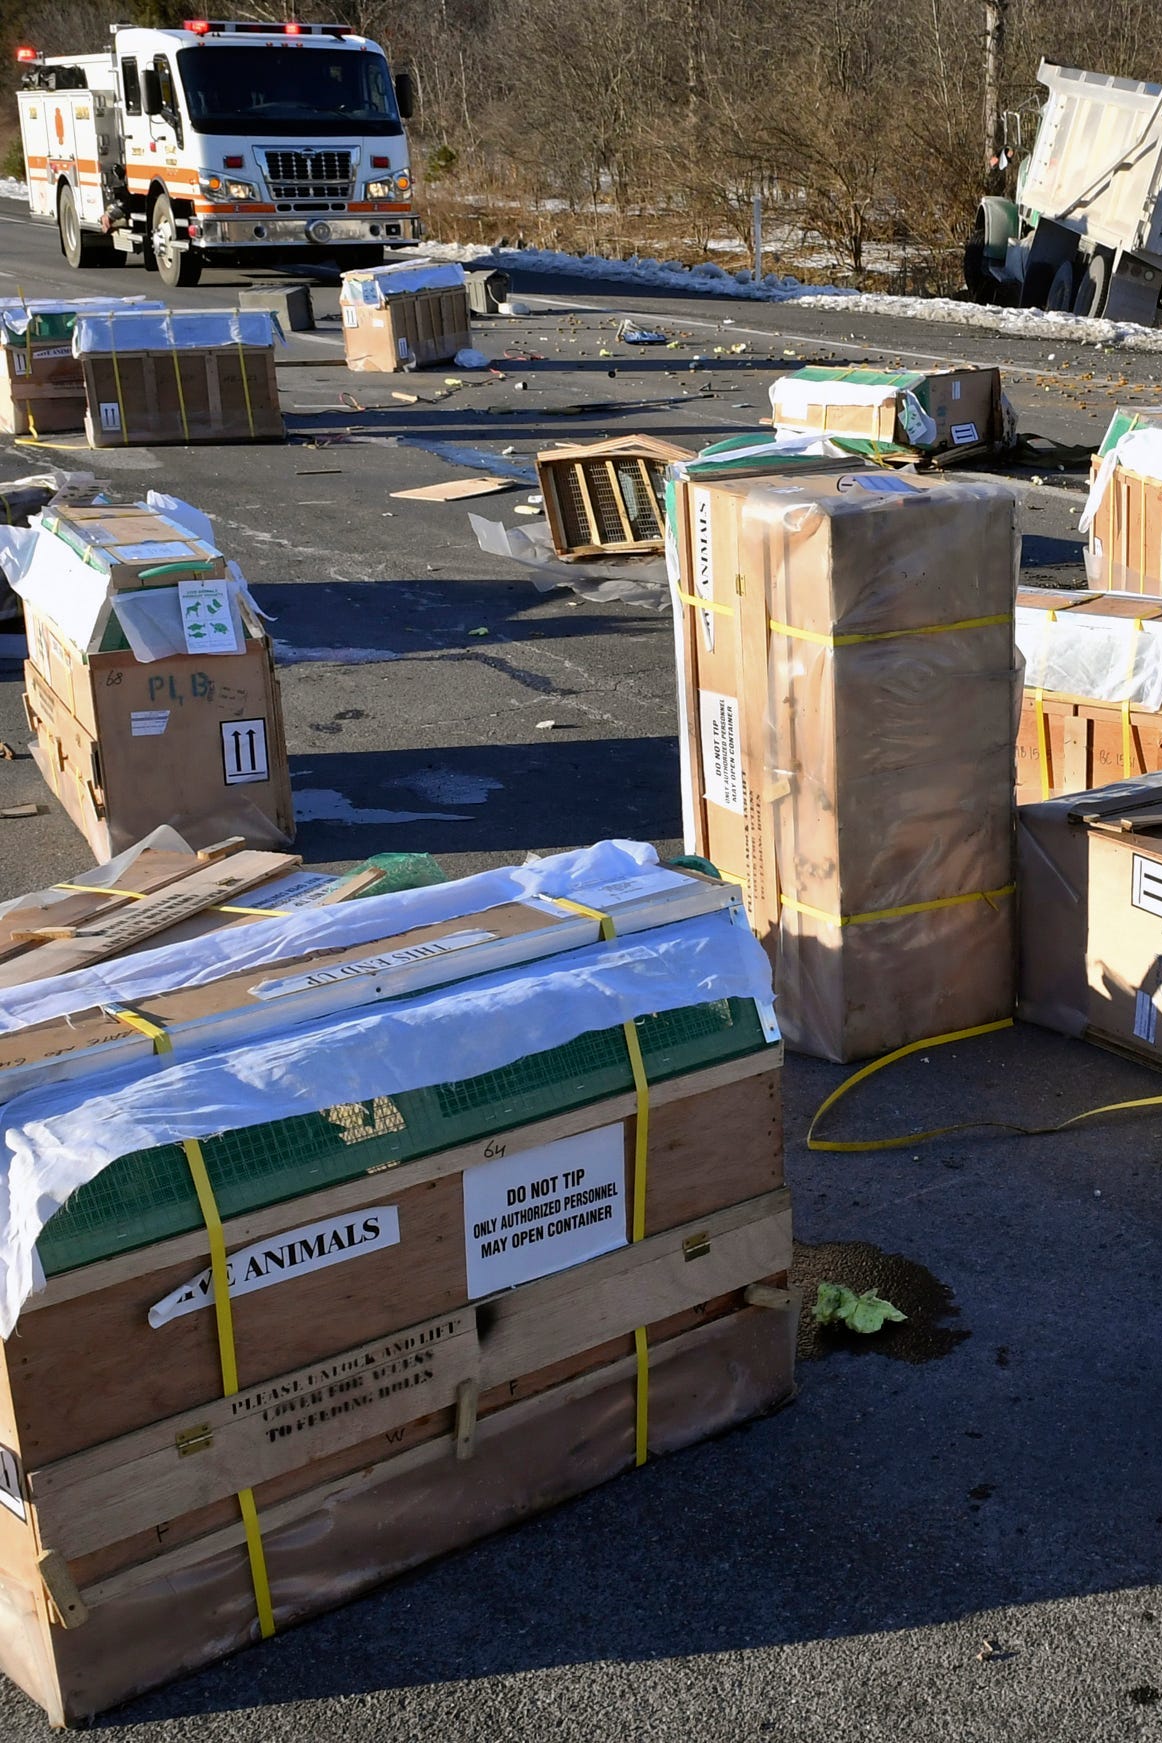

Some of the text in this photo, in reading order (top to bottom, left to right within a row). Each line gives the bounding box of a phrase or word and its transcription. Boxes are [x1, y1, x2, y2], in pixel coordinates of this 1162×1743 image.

[106, 670, 123, 686] 68
[727, 705, 735, 755] CONTAINER
[713, 739, 721, 761] NOT
[306, 942, 451, 987] THIS END UP
[483, 1141, 507, 1160] 64
[506, 1168, 587, 1206] DO NOT TIP
[473, 1181, 619, 1240] ONLY AUTHORIZED PERSONNEL
[480, 1204, 613, 1259] MAY OPEN CONTAINER
[243, 1216, 382, 1283] ANIMALS
[420, 1320, 456, 1346] LIFT
[266, 1425, 292, 1443] TO
[385, 1427, 408, 1444] W
